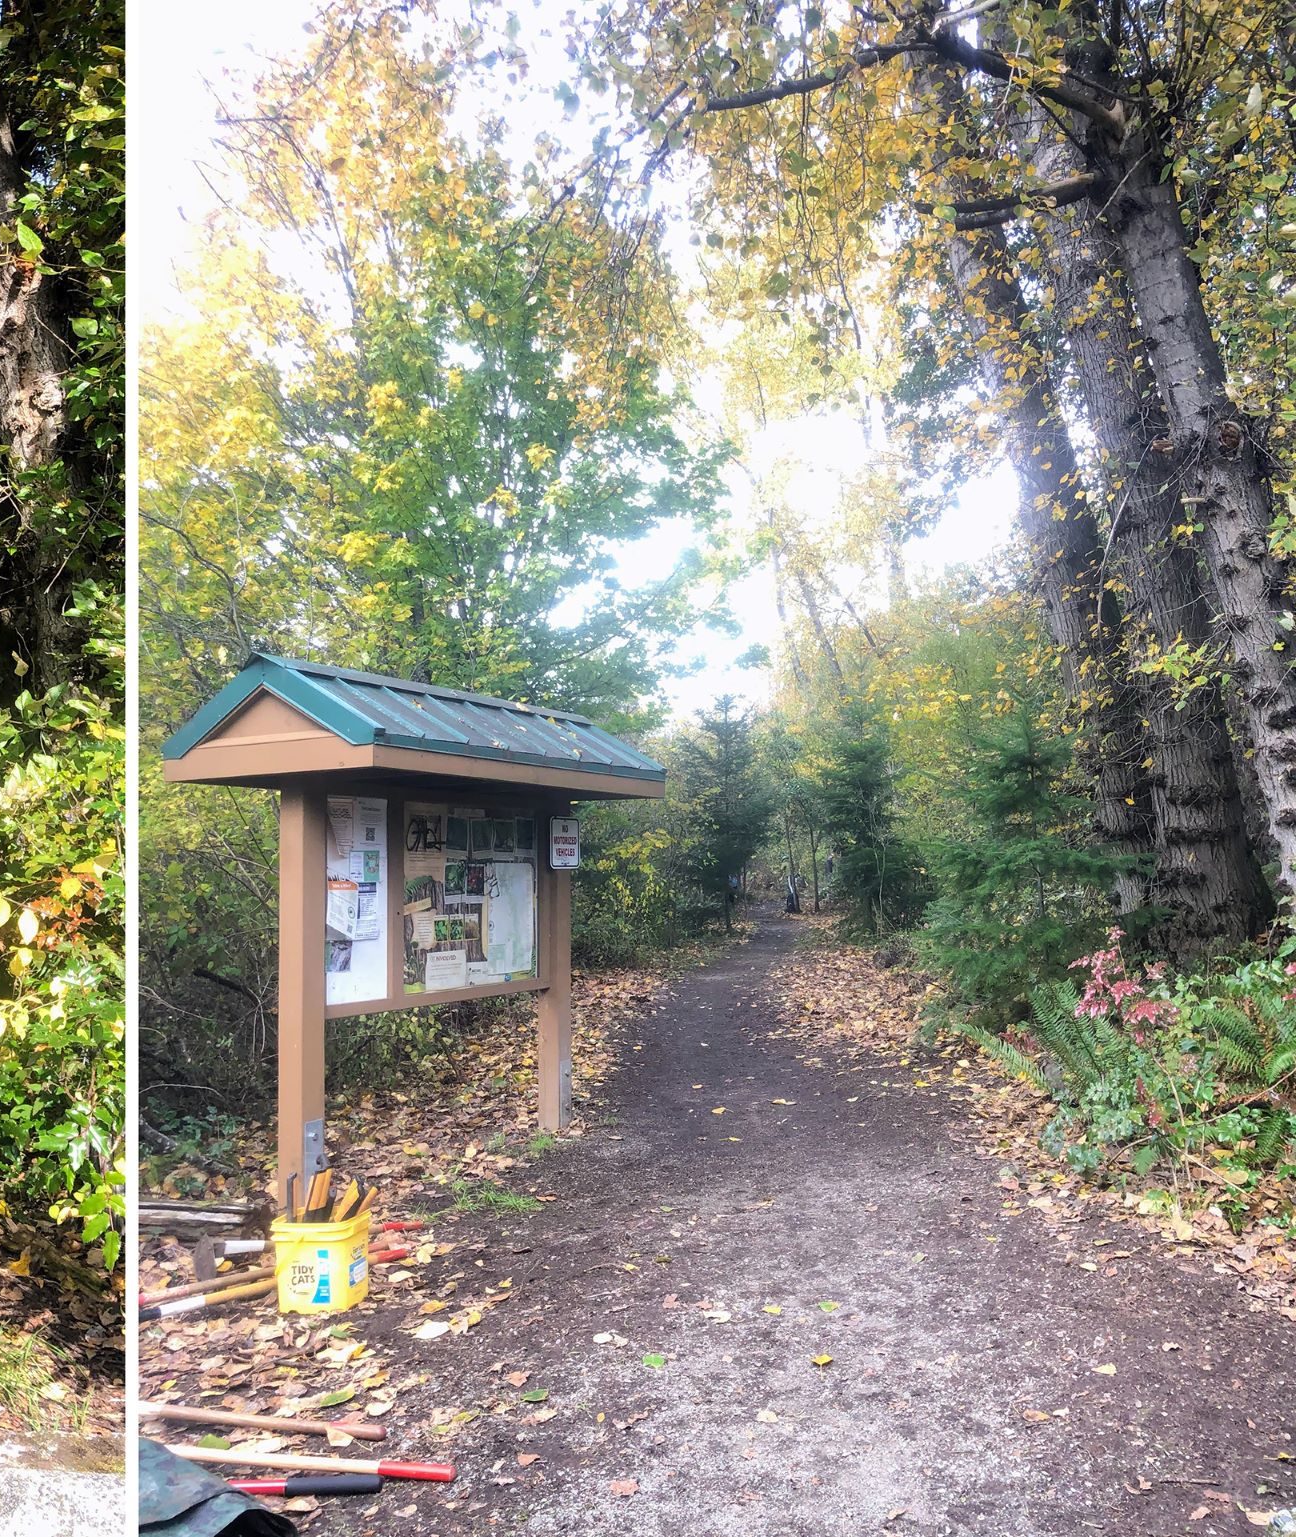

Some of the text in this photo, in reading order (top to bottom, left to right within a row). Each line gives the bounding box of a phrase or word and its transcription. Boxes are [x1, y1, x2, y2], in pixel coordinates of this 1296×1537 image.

[561, 824, 569, 833] NO
[553, 835, 577, 845] MOTORIZED
[555, 847, 576, 857] VEHICLES
[291, 1265, 314, 1275] TIDY
[291, 1275, 315, 1286] CATS
